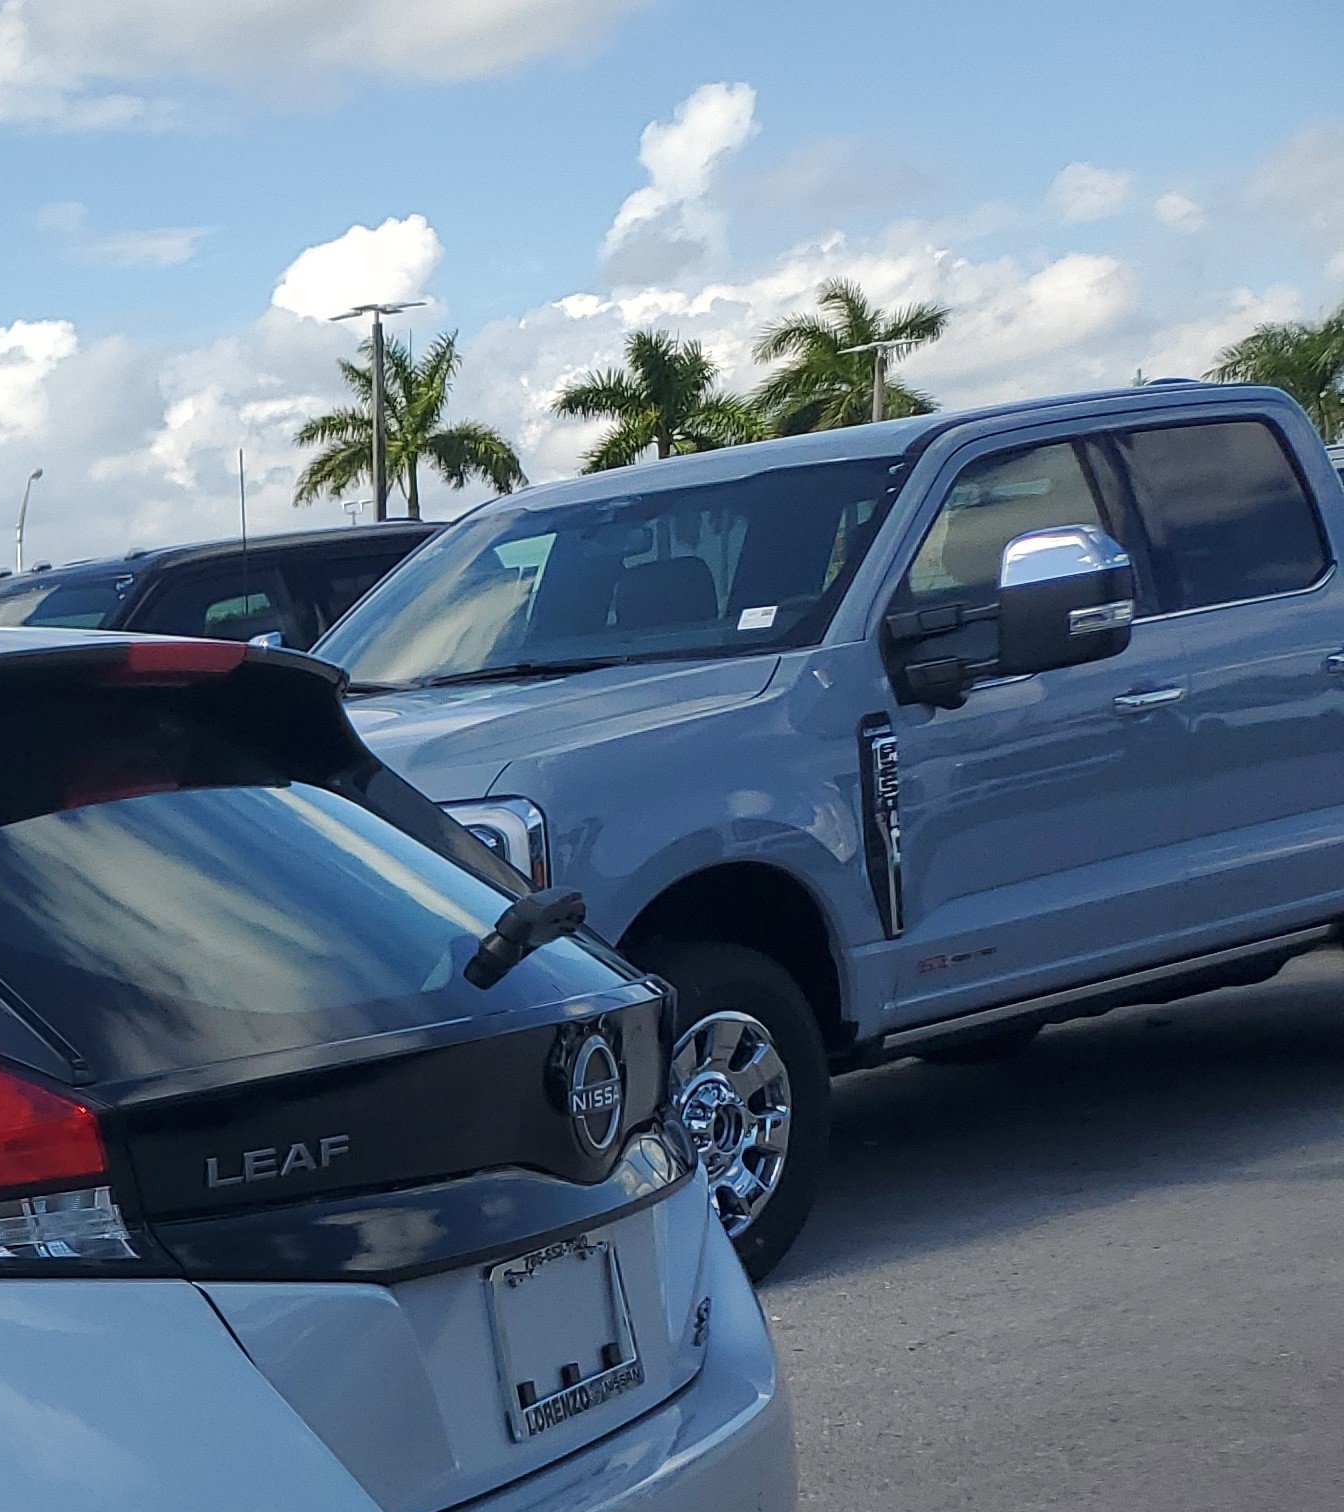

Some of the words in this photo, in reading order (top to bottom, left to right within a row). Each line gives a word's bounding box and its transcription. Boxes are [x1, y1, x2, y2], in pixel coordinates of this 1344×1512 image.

[572, 1085, 620, 1114] NISSA
[205, 1133, 350, 1188] LEAF
[525, 1385, 591, 1437] LORENZO
